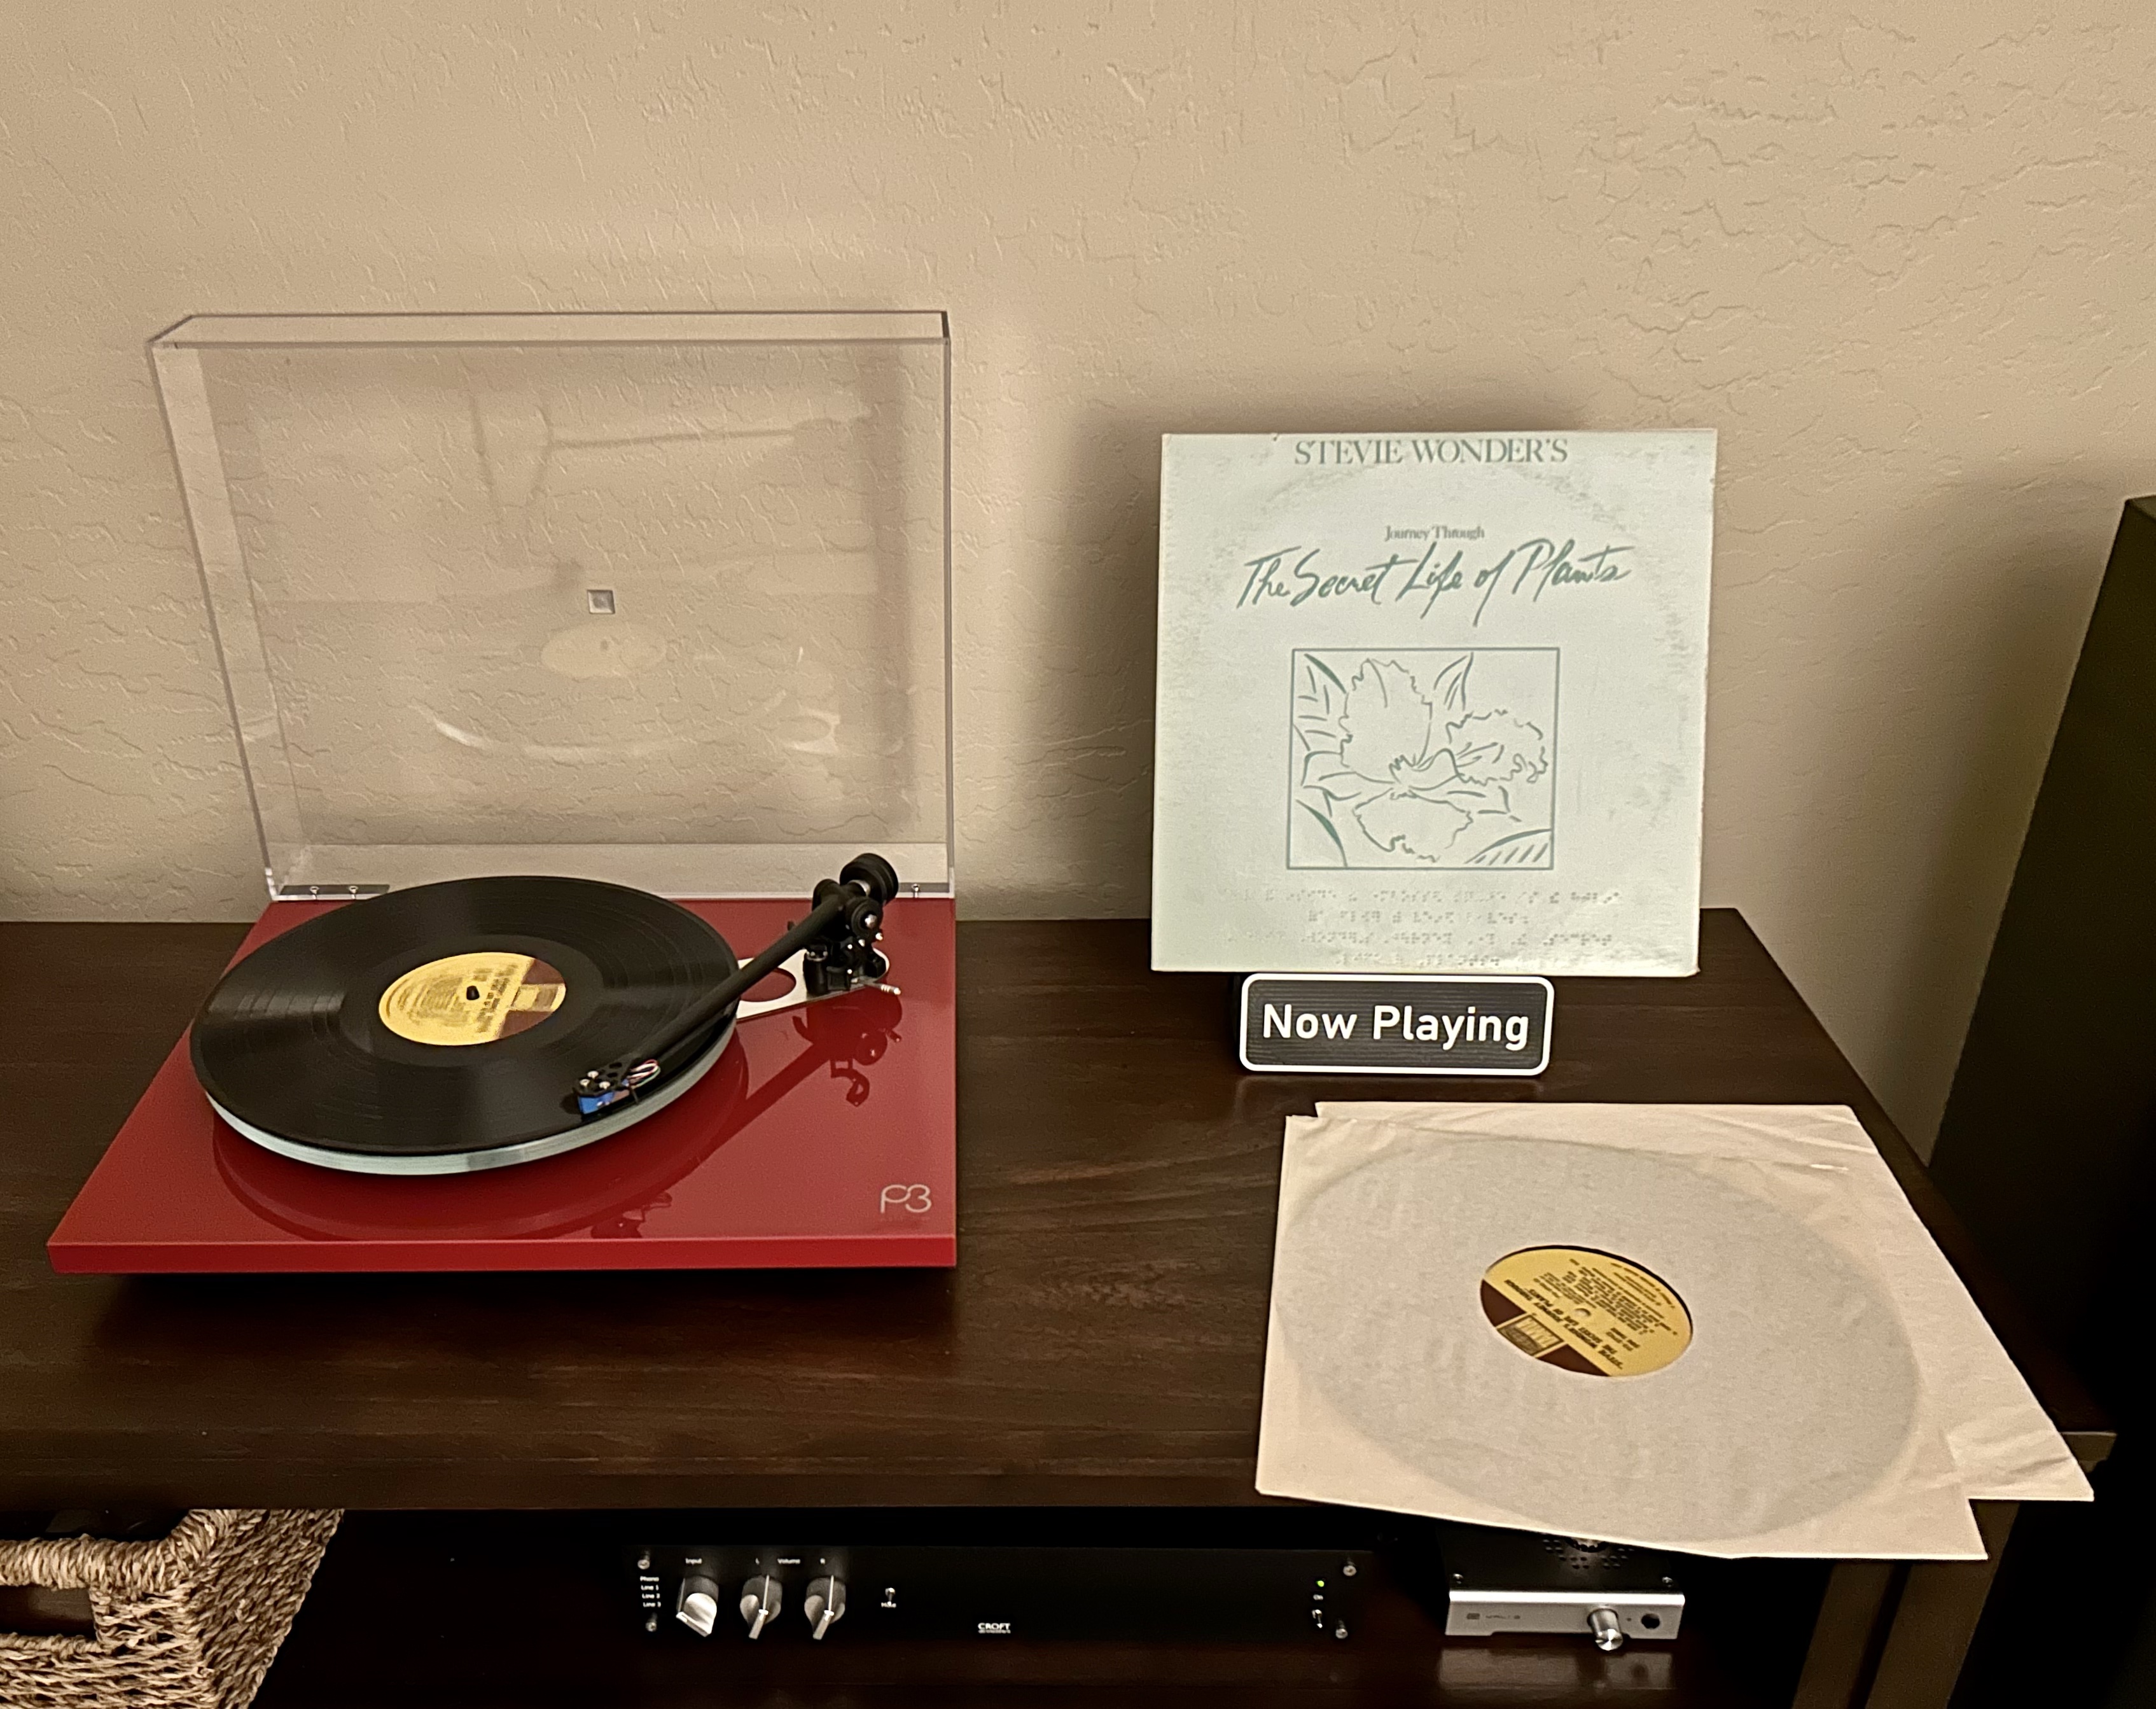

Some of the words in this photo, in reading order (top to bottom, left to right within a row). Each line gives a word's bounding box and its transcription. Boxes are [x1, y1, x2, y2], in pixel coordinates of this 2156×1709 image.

[1295, 439, 1401, 464] STEVIE
[1410, 438, 1569, 463] WONDER'S
[1384, 524, 1430, 541] Journey
[1431, 524, 1485, 540] Through
[1236, 545, 1302, 609] The
[1290, 548, 1418, 607] Secret
[1394, 541, 1464, 620] Life
[1473, 549, 1517, 627] of
[1512, 538, 1636, 602] Plants
[1262, 1003, 1358, 1040] Now
[1372, 1005, 1529, 1051] Playing
[880, 1183, 933, 1213] P3
